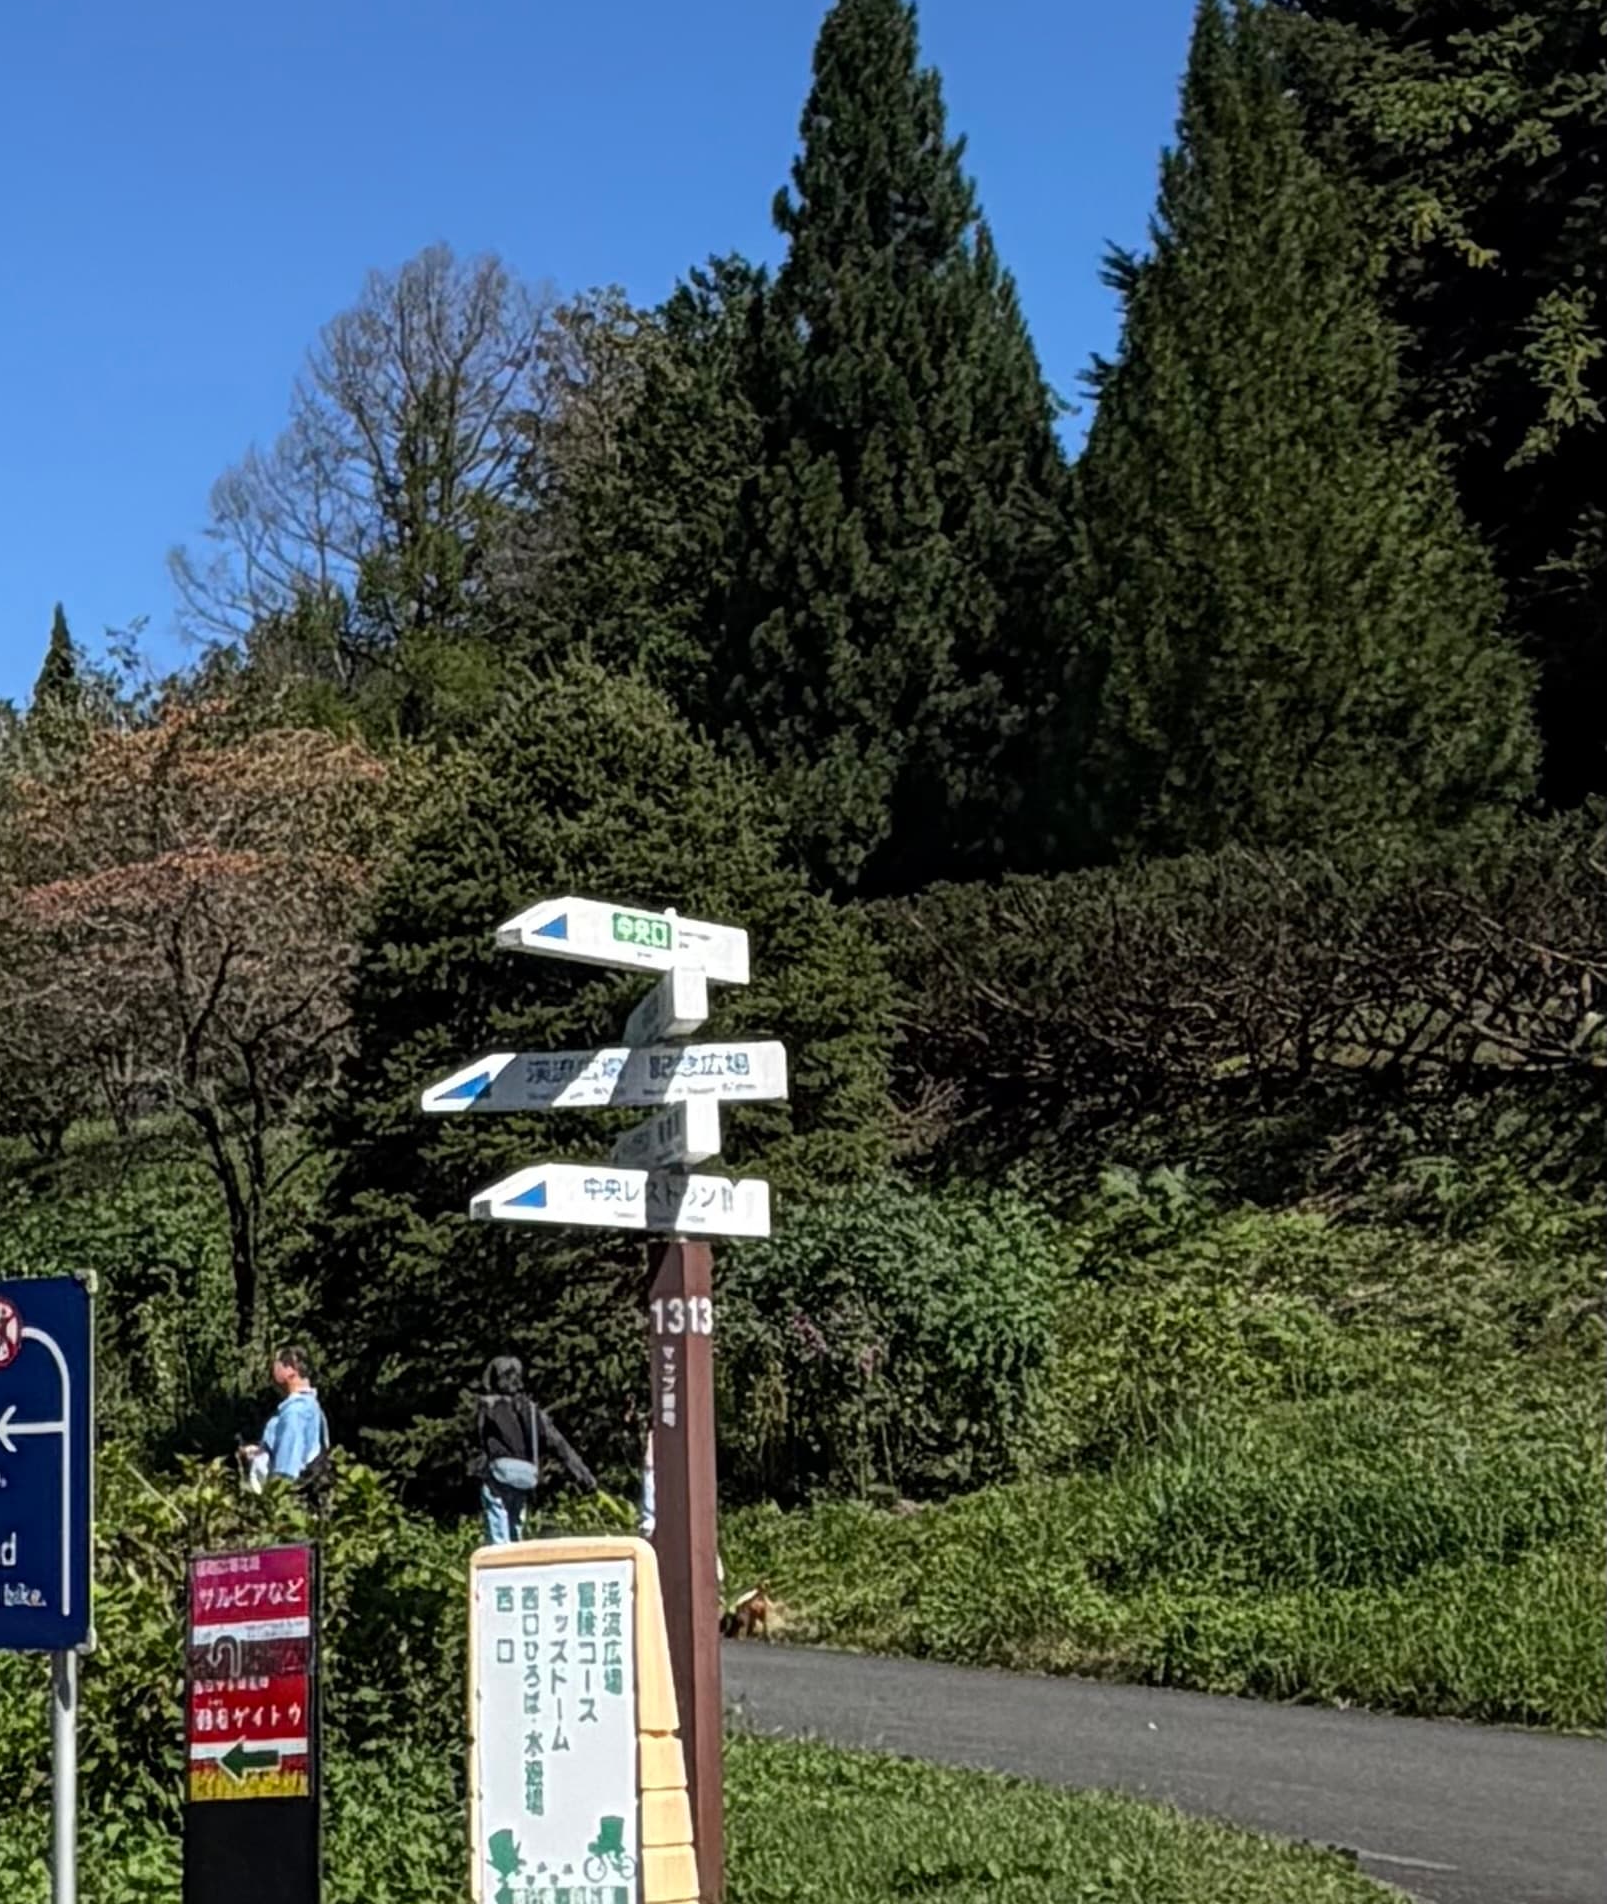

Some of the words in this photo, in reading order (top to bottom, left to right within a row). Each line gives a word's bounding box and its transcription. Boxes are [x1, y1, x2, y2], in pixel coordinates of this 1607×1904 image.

[651, 1297, 685, 1335] 13
[688, 1295, 713, 1335] 13
[3, 1582, 47, 1608] bike.
